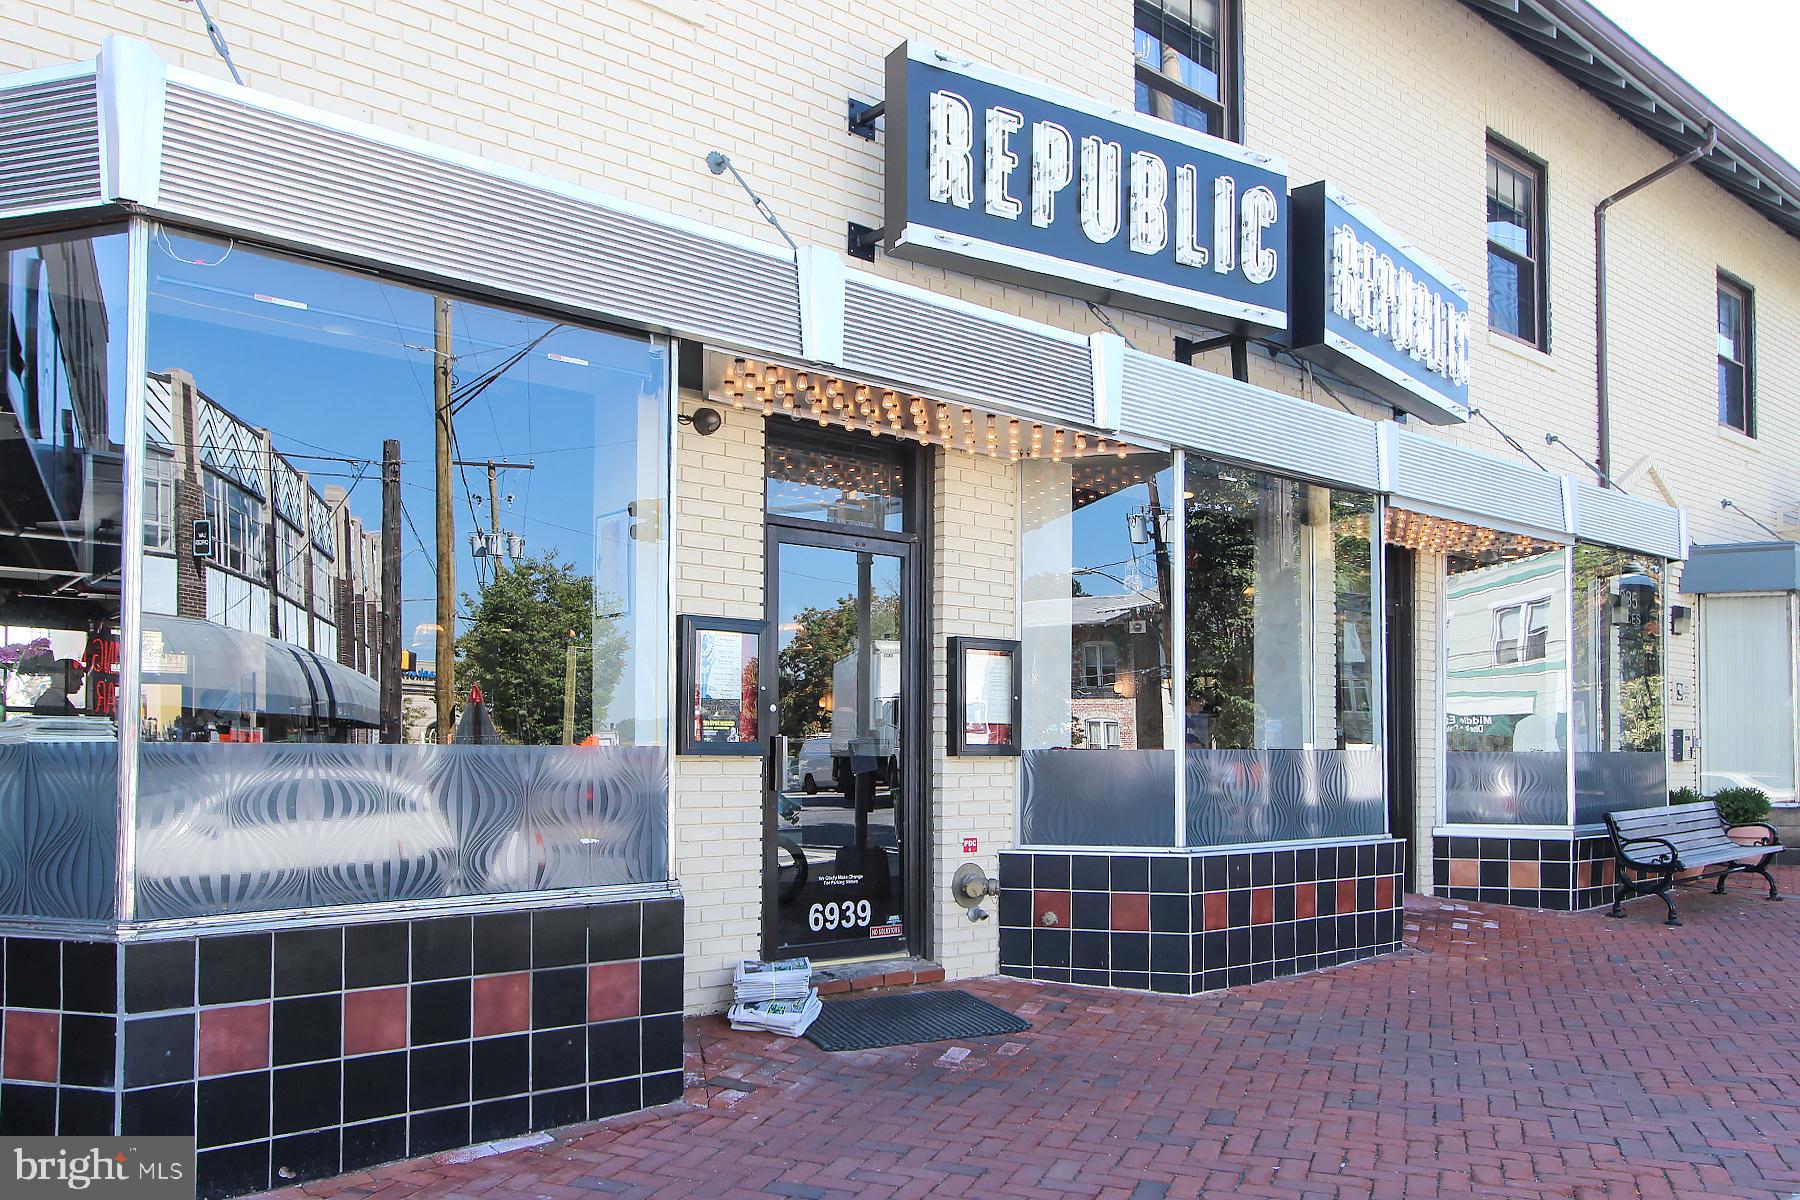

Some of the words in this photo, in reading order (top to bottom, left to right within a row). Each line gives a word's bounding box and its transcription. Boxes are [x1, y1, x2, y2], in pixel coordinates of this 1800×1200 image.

[929, 90, 1278, 284] REPUBLIC
[1333, 224, 1470, 387] REPUBLIC
[808, 899, 872, 932] 6939
[871, 928, 878, 936] NO
